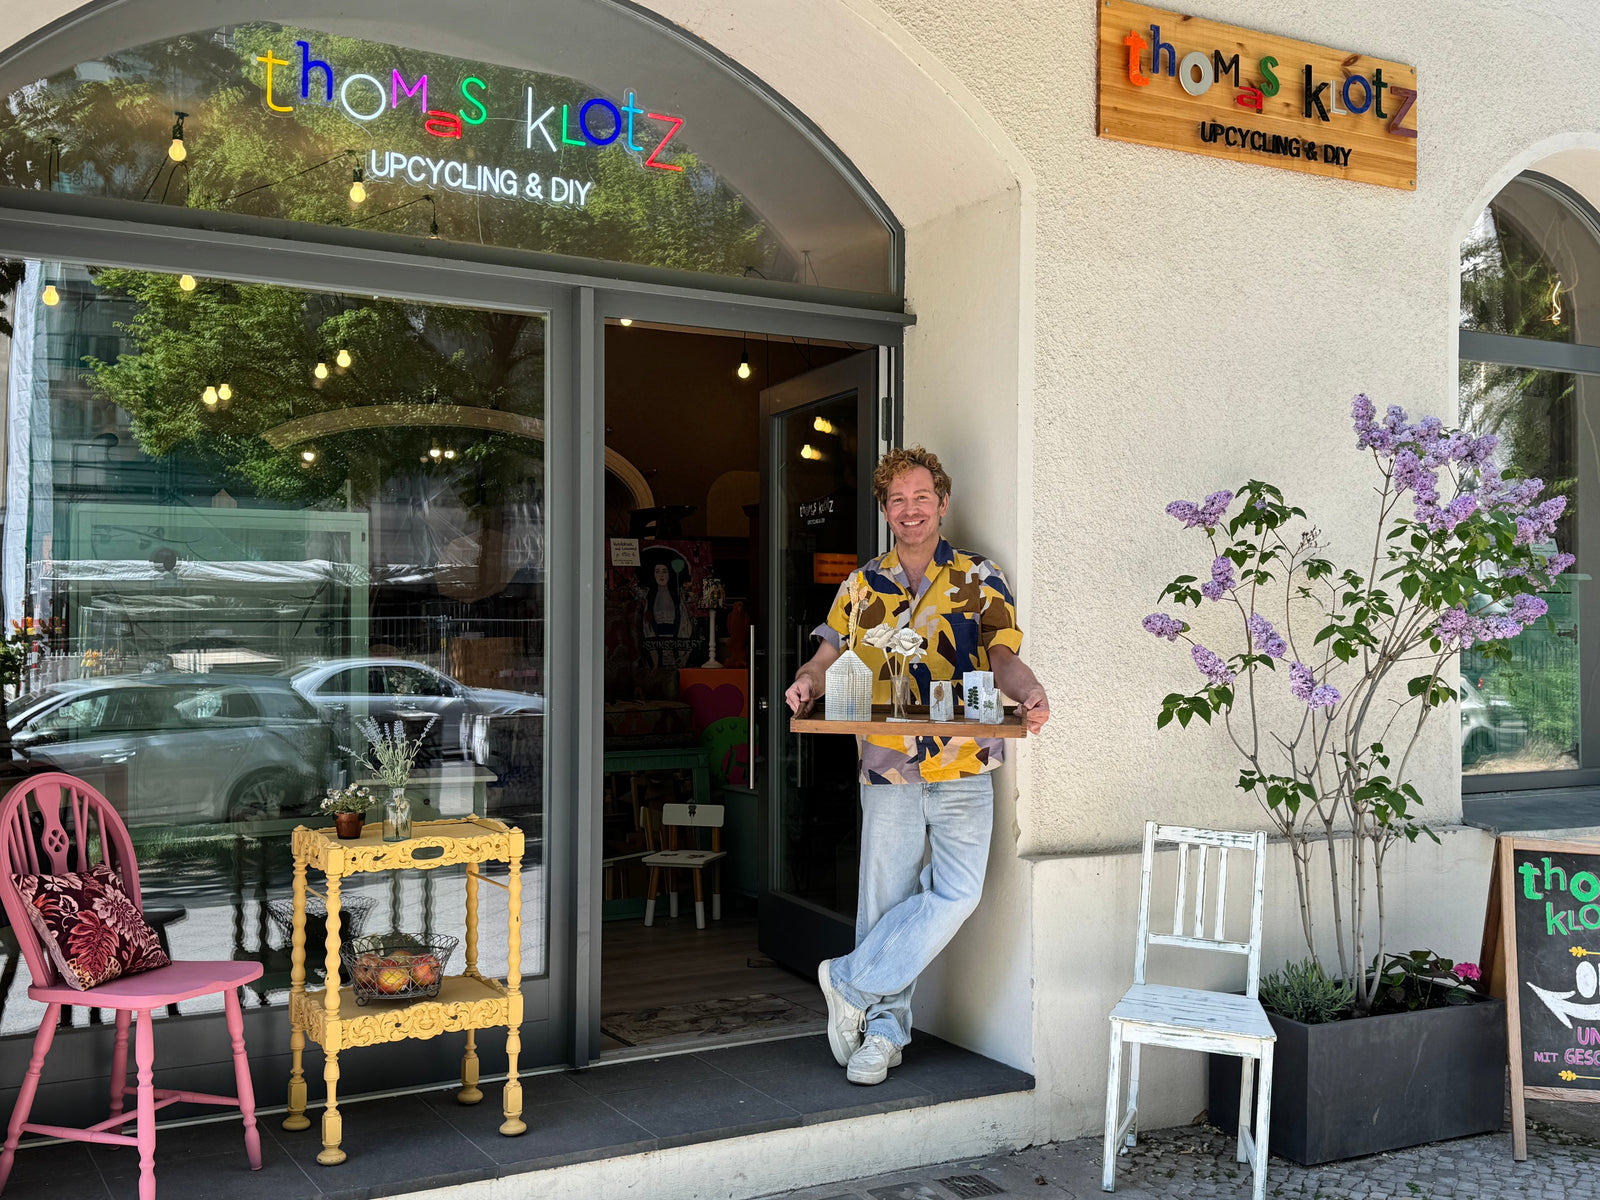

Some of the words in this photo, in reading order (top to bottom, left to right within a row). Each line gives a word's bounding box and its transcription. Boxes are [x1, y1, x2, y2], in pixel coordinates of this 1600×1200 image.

[1200, 121, 1301, 158] UPCYCLING
[1305, 141, 1319, 162] &
[1323, 144, 1352, 167] DIY
[371, 149, 518, 196] UPCYCLING
[525, 172, 544, 200] &
[551, 176, 592, 206] DIY
[1575, 960, 1600, 999] O
[1534, 1051, 1560, 1063] MIT
